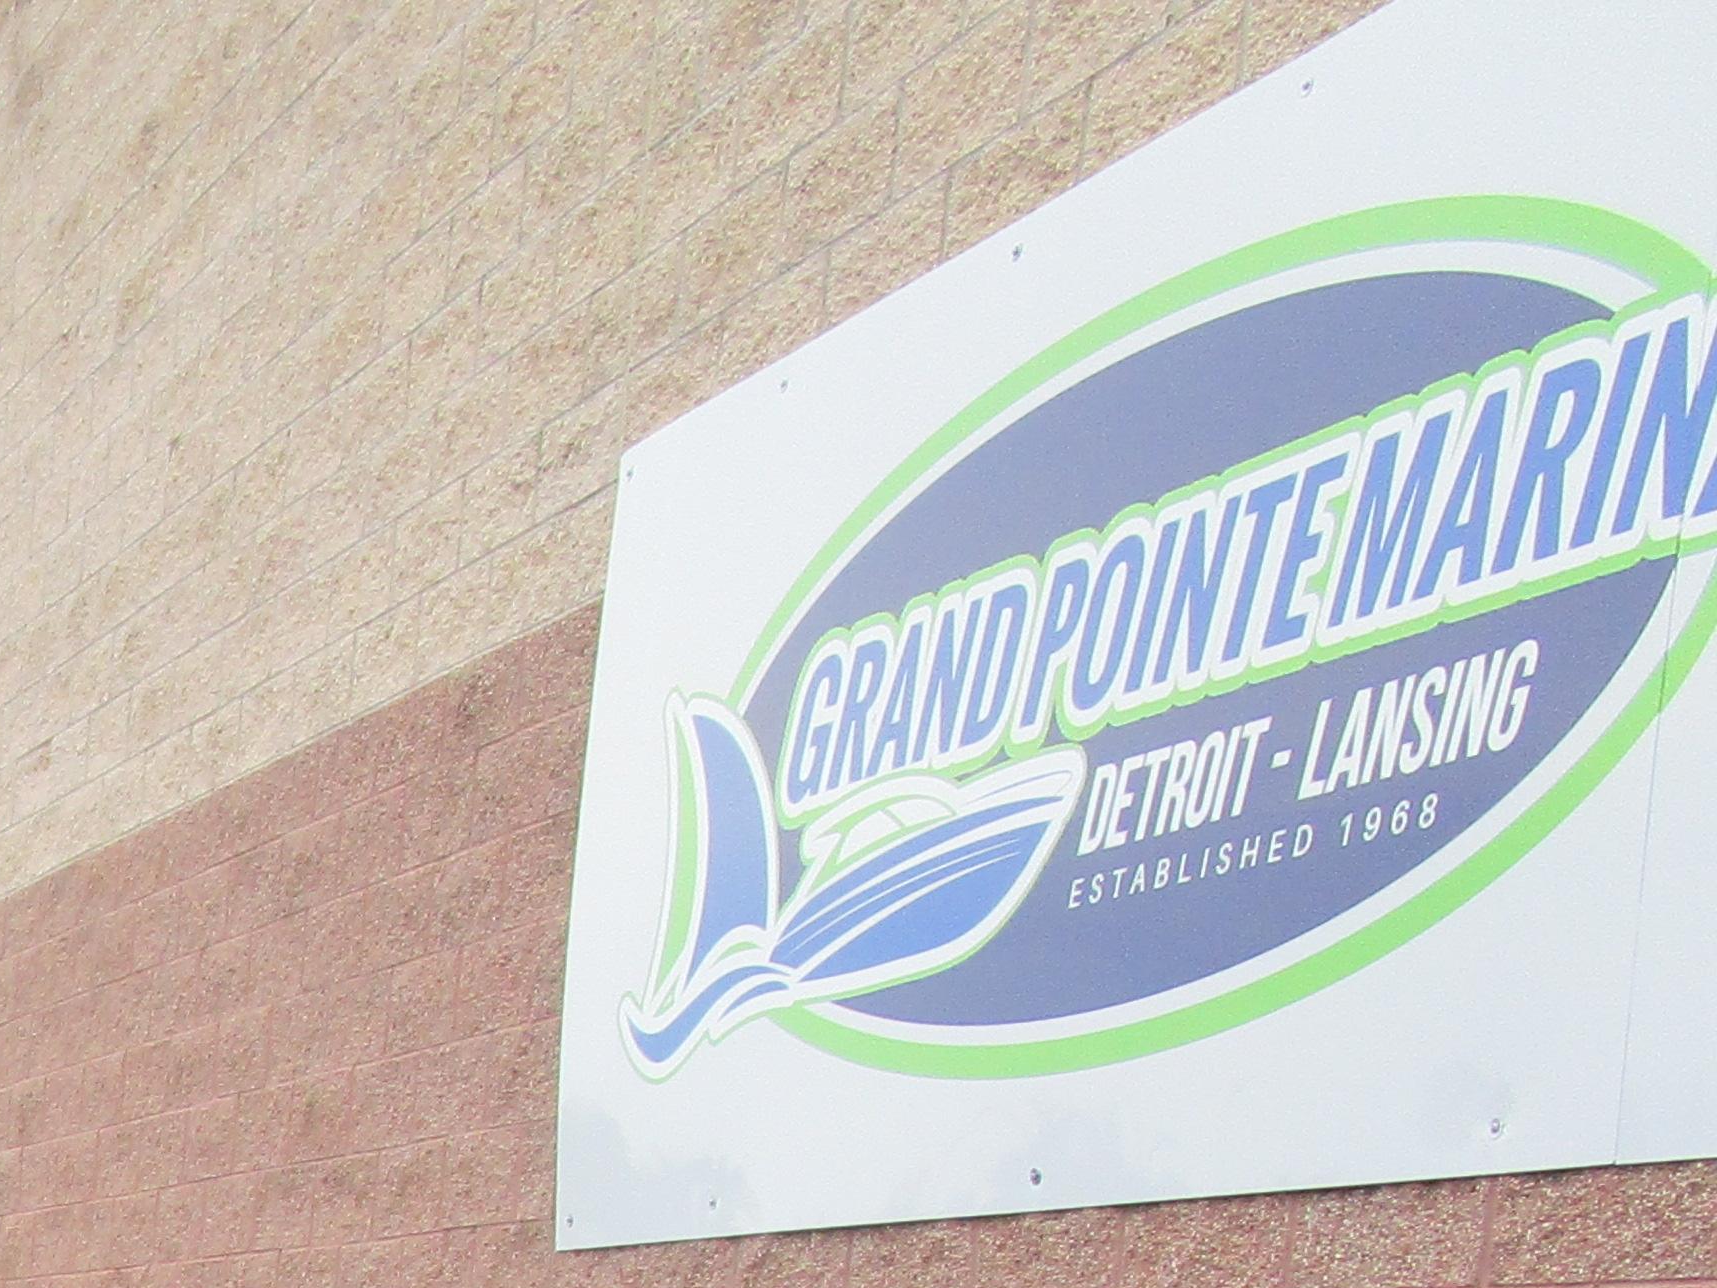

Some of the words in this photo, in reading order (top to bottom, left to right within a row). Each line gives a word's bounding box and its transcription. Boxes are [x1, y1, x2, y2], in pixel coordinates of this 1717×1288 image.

[1326, 312, 1717, 631] MARIN
[1067, 824, 1314, 909] ESTABLISHED
[1339, 792, 1440, 846] 1968
[1077, 716, 1273, 856] DETROIT
[1297, 639, 1540, 801] LANSING
